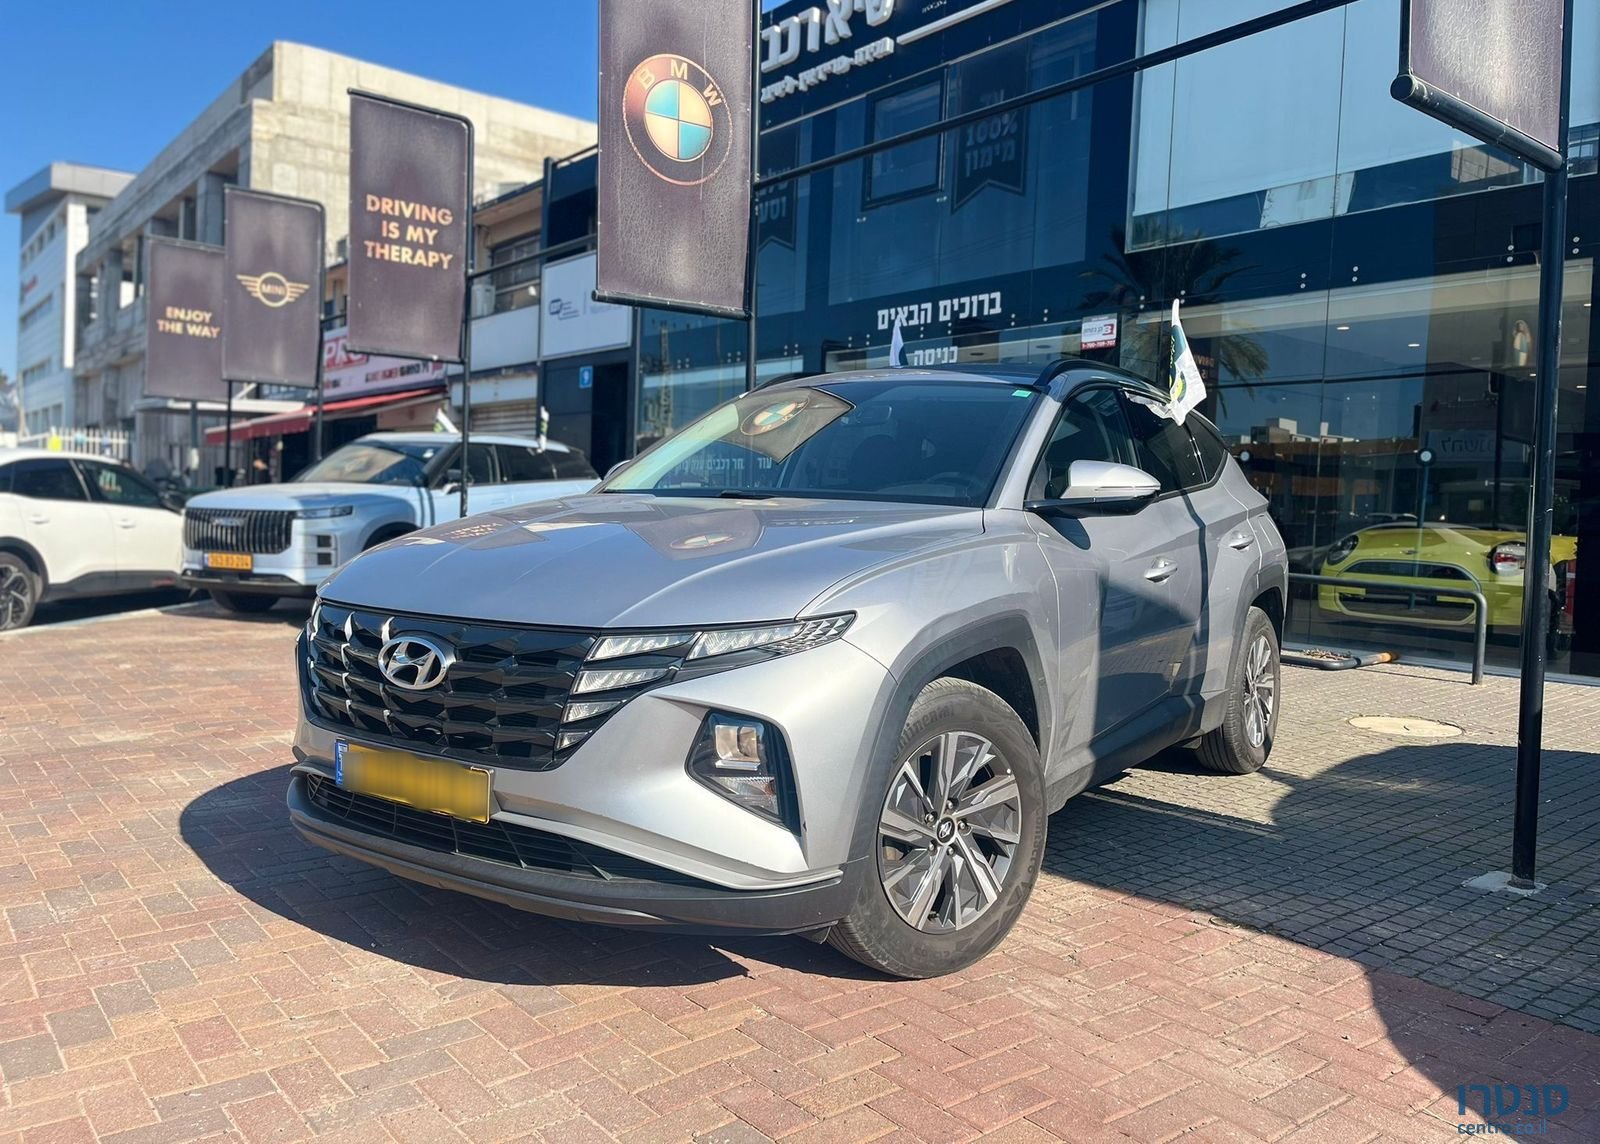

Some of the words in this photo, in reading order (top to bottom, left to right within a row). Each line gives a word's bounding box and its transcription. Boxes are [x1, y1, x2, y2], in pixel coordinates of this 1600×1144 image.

[639, 59, 722, 107] BMW
[366, 193, 453, 225] DRIVING
[382, 220, 400, 239] IS
[406, 225, 438, 245] MY
[364, 241, 453, 270] THERAPY
[261, 284, 286, 296] MINI
[166, 306, 212, 323] ENJOY
[877, 302, 932, 330] הבאים
[939, 291, 1001, 321] ברוכים
[157, 319, 183, 335] THE
[186, 323, 220, 338] WAY
[913, 346, 958, 366] כניסה
